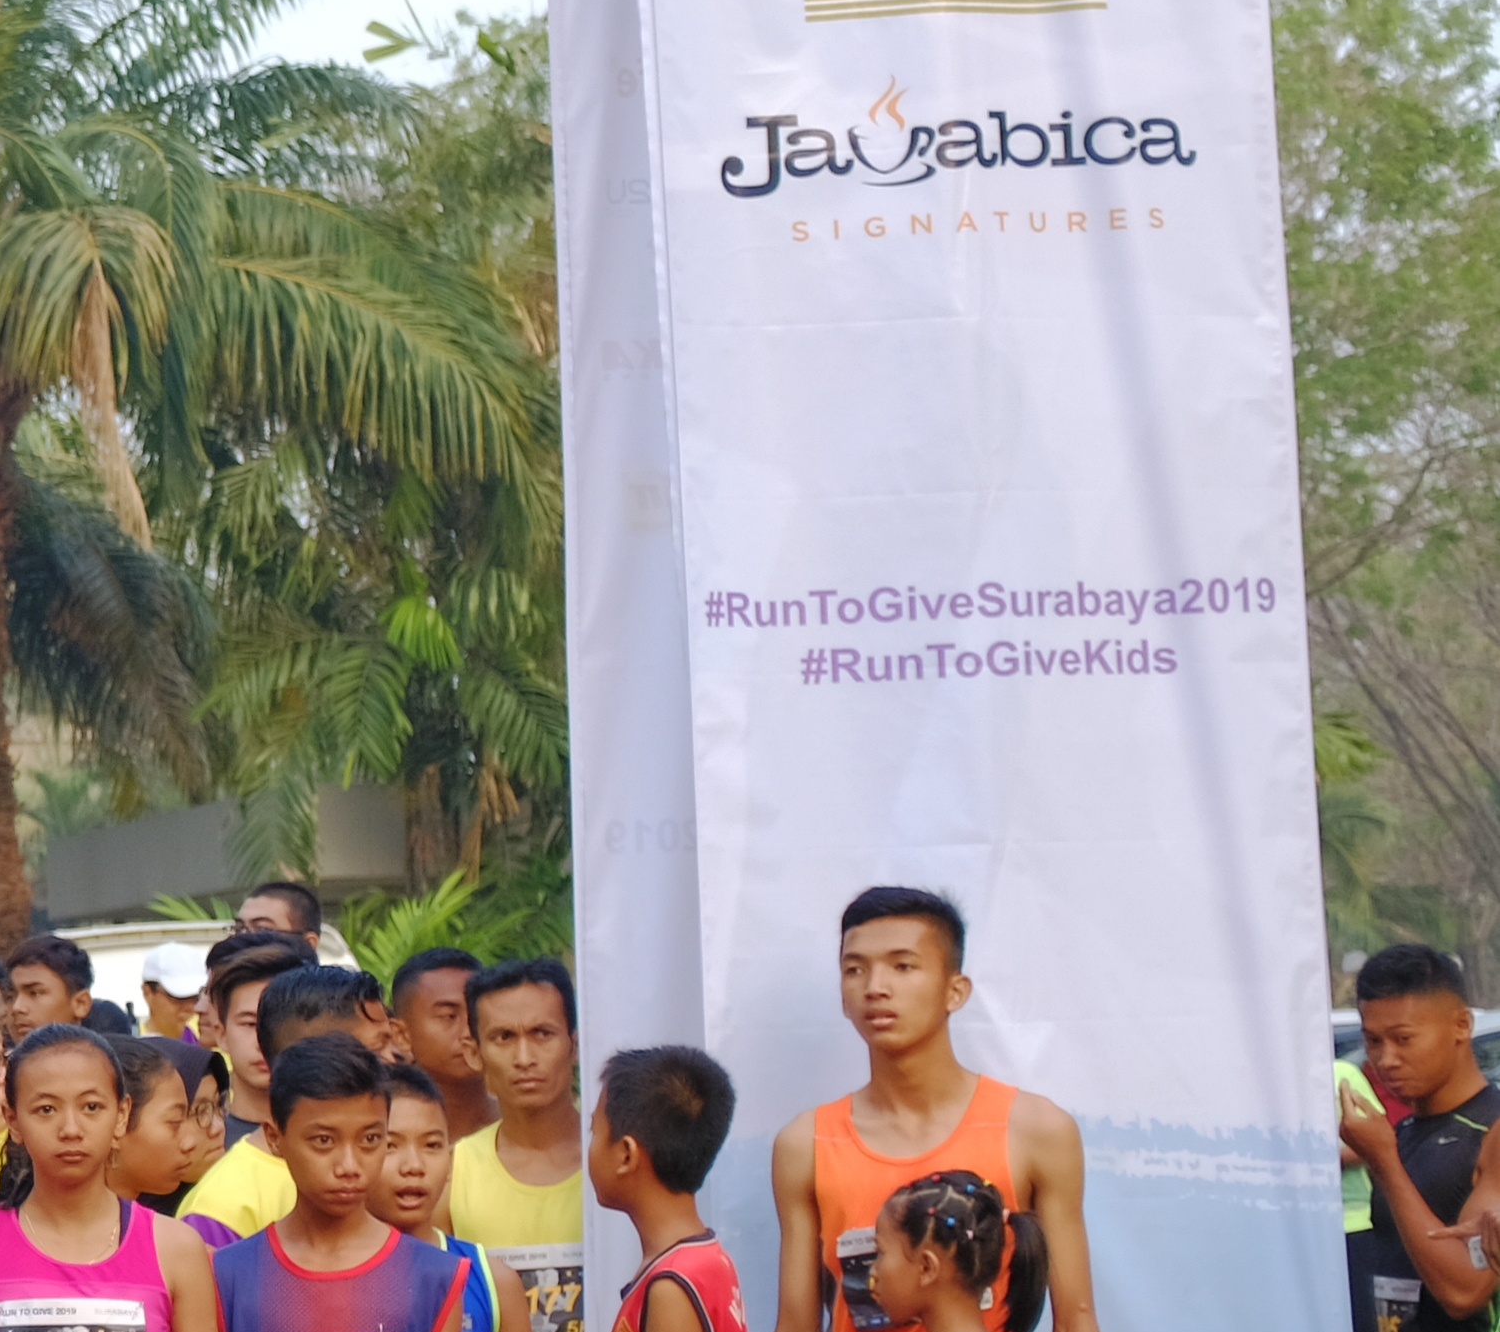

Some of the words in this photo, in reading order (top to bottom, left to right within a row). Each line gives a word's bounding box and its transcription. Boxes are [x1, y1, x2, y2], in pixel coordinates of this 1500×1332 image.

[792, 207, 1165, 243] SIGNATURES
[706, 577, 1275, 628] #RunToGiveSurabaya2019
[802, 639, 1178, 684] #RunToGiveKids
[526, 1284, 582, 1315] 177
